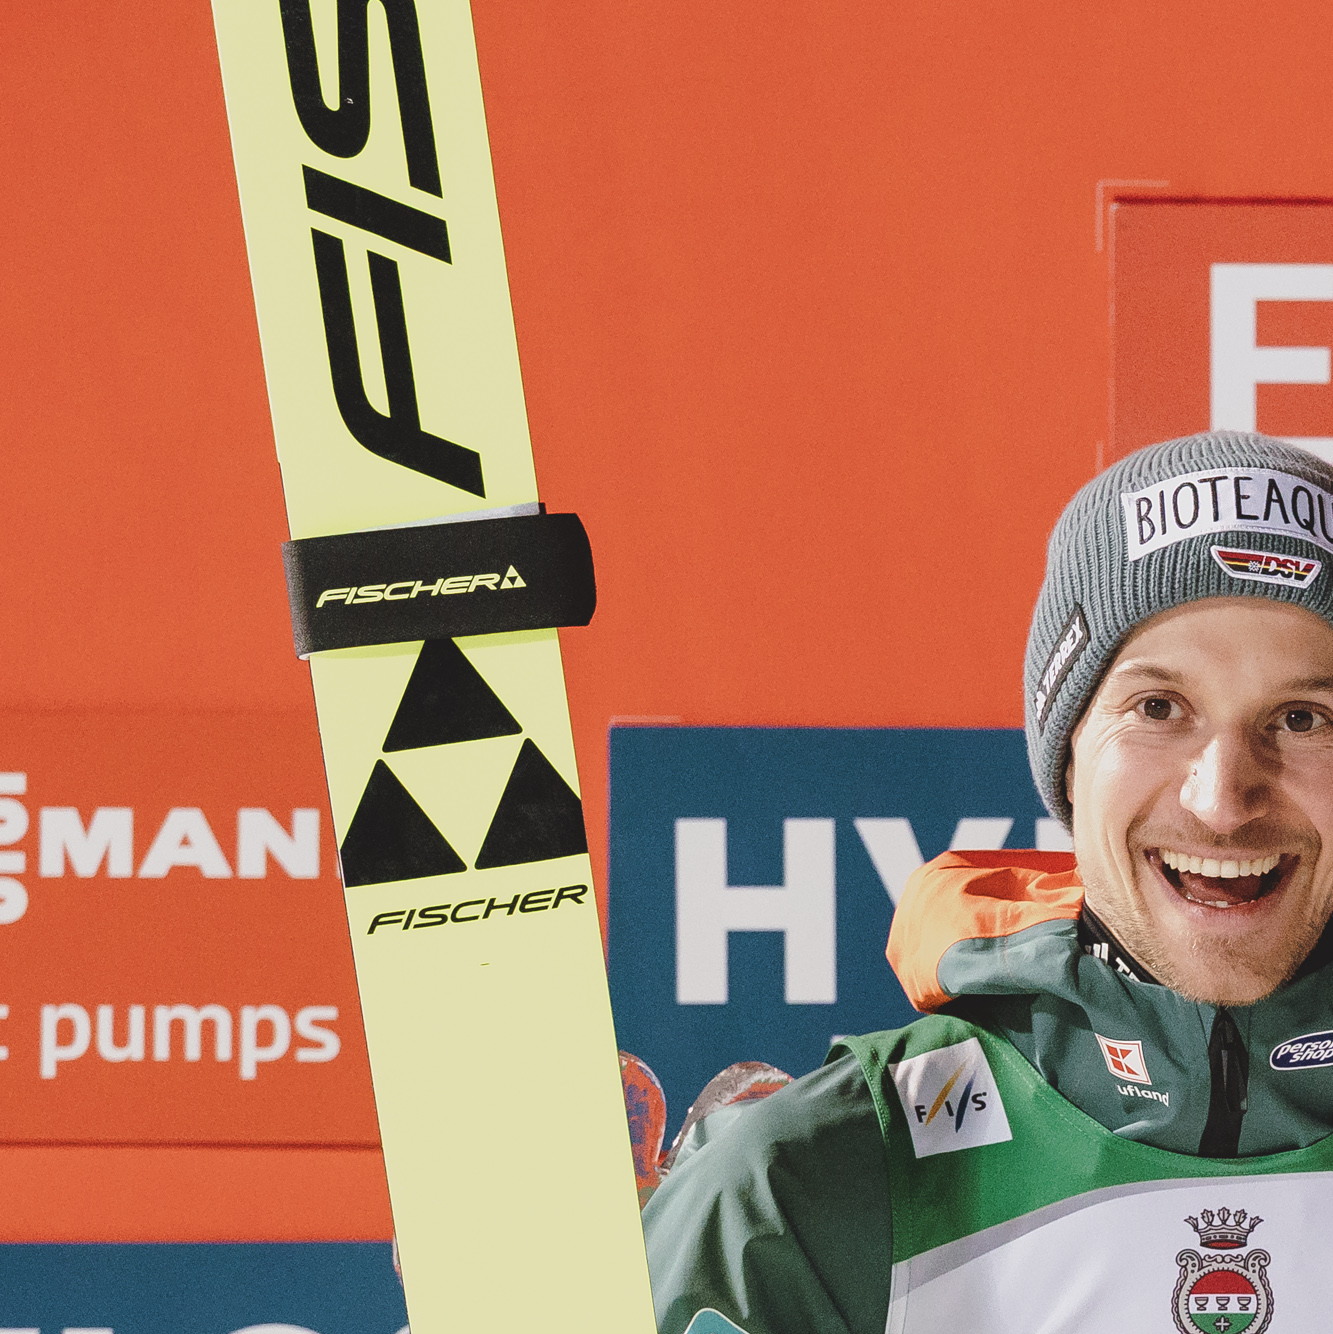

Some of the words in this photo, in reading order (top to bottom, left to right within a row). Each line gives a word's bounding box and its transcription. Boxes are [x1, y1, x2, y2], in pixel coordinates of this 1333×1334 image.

[316, 573, 502, 608] FISCHER
[1261, 555, 1316, 583] DSV
[1043, 616, 1083, 696] TERREX
[367, 884, 589, 935] FISCHER
[39, 1002, 342, 1080] pumps
[914, 1091, 988, 1123] FIS
